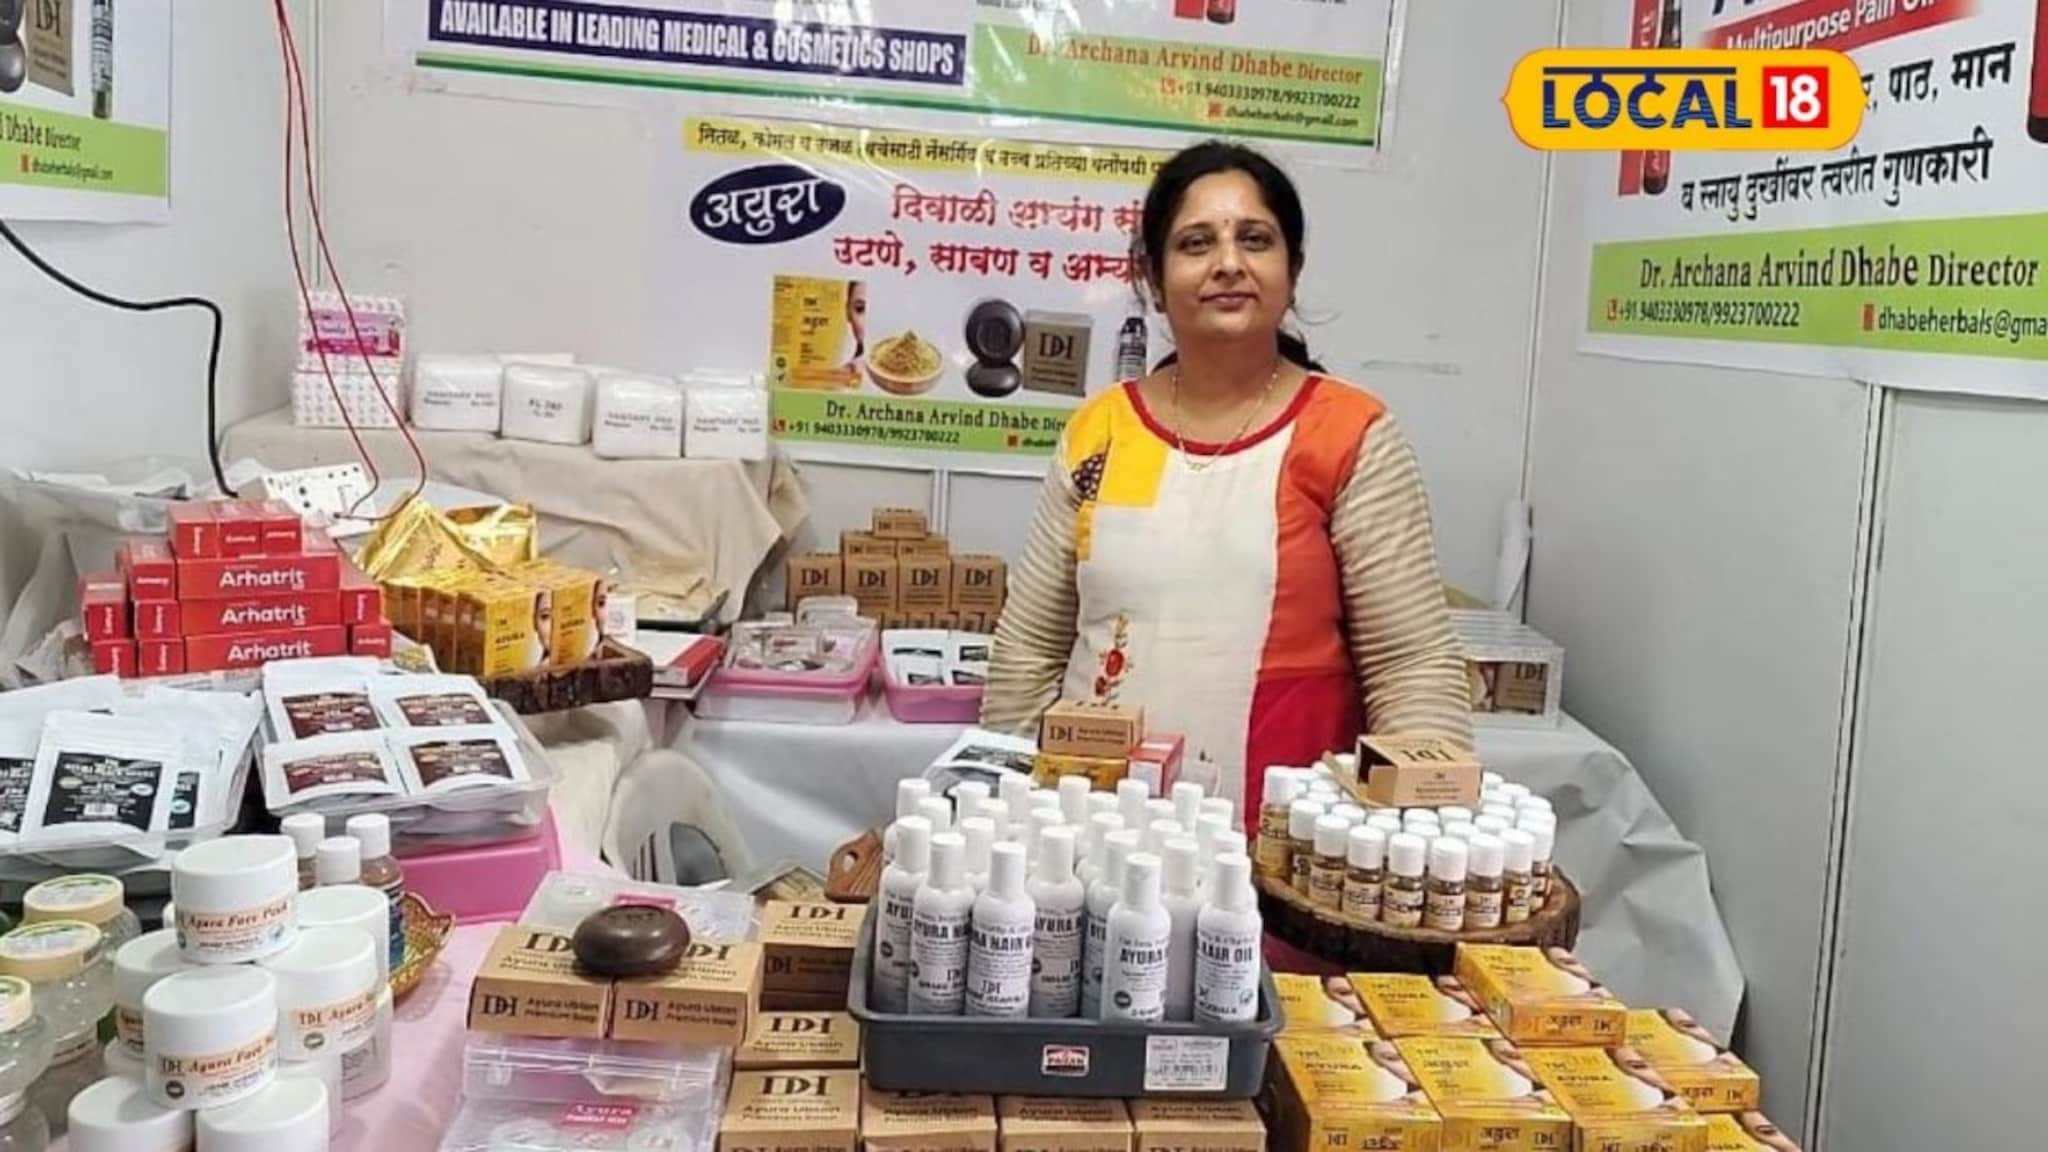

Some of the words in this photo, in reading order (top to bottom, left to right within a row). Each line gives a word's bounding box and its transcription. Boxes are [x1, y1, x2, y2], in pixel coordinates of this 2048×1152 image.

[440, 1, 548, 41] AVAILABLE
[551, 9, 574, 44] IN
[576, 11, 660, 52] LEADING
[663, 20, 749, 59] MEDICAL
[753, 31, 769, 62] &
[773, 28, 884, 70] COSMETICS
[889, 40, 955, 75] SHOPS
[1065, 38, 1150, 66] Archana
[1156, 47, 1224, 72] Arvind
[1230, 51, 1294, 78] Dhabe
[1298, 62, 1364, 84] Director
[1889, 59, 1938, 103] पाठ,
[1952, 42, 2016, 90] मान
[1681, 182, 1695, 211] व
[1821, 145, 1878, 197] त्वरीत
[1883, 125, 1994, 208] गुणकारी
[892, 183, 996, 227] दिवाळी
[833, 230, 918, 275] उटणे,
[929, 242, 1019, 277] साबण
[1028, 250, 1053, 279] व
[1640, 258, 1665, 288] Dr.
[1670, 252, 1752, 288] Archana
[1758, 248, 1836, 288] Arvind
[1840, 244, 1919, 287] Dhabe
[1928, 251, 2038, 287] Director
[789, 420, 809, 434] +91
[827, 400, 852, 420] Dr.
[856, 402, 924, 424] Archana
[930, 407, 984, 428] Arvind
[989, 410, 1040, 430] Dhabe
[219, 567, 305, 589] Arhatrit
[221, 604, 308, 625] Arhatrit
[227, 639, 313, 662] Arhatrit
